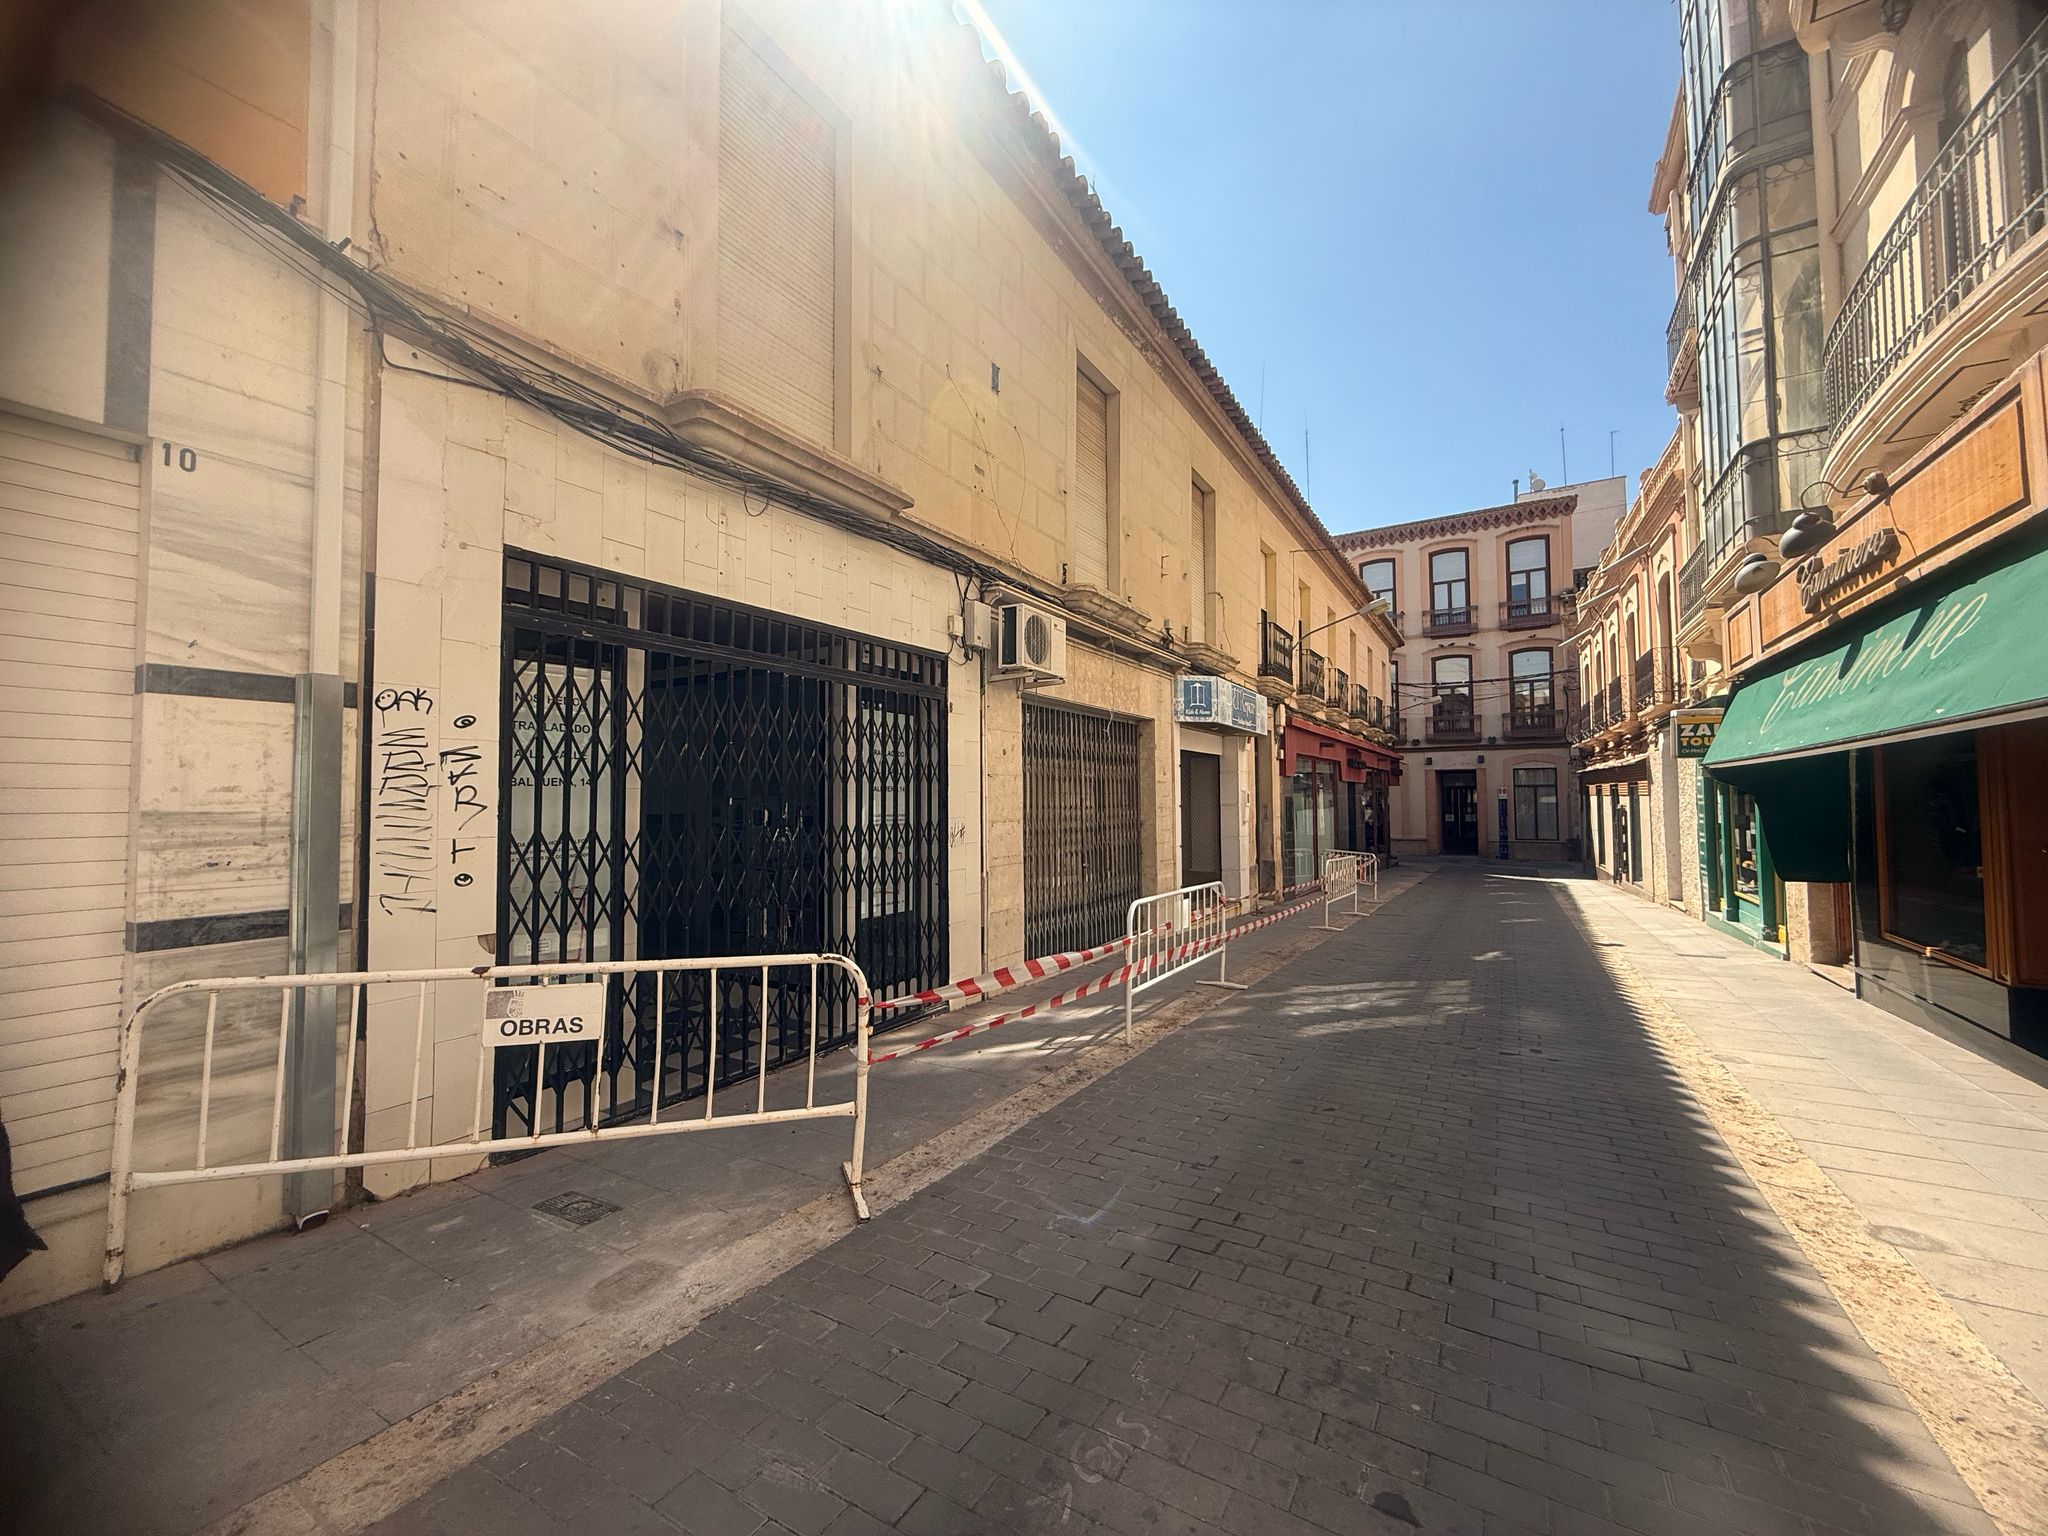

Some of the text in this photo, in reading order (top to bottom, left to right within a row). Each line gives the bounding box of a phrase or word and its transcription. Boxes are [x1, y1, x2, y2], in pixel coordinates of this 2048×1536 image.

[162, 442, 197, 473] 10
[512, 720, 591, 734] TRALADDO
[500, 1016, 584, 1037] OBRAS
